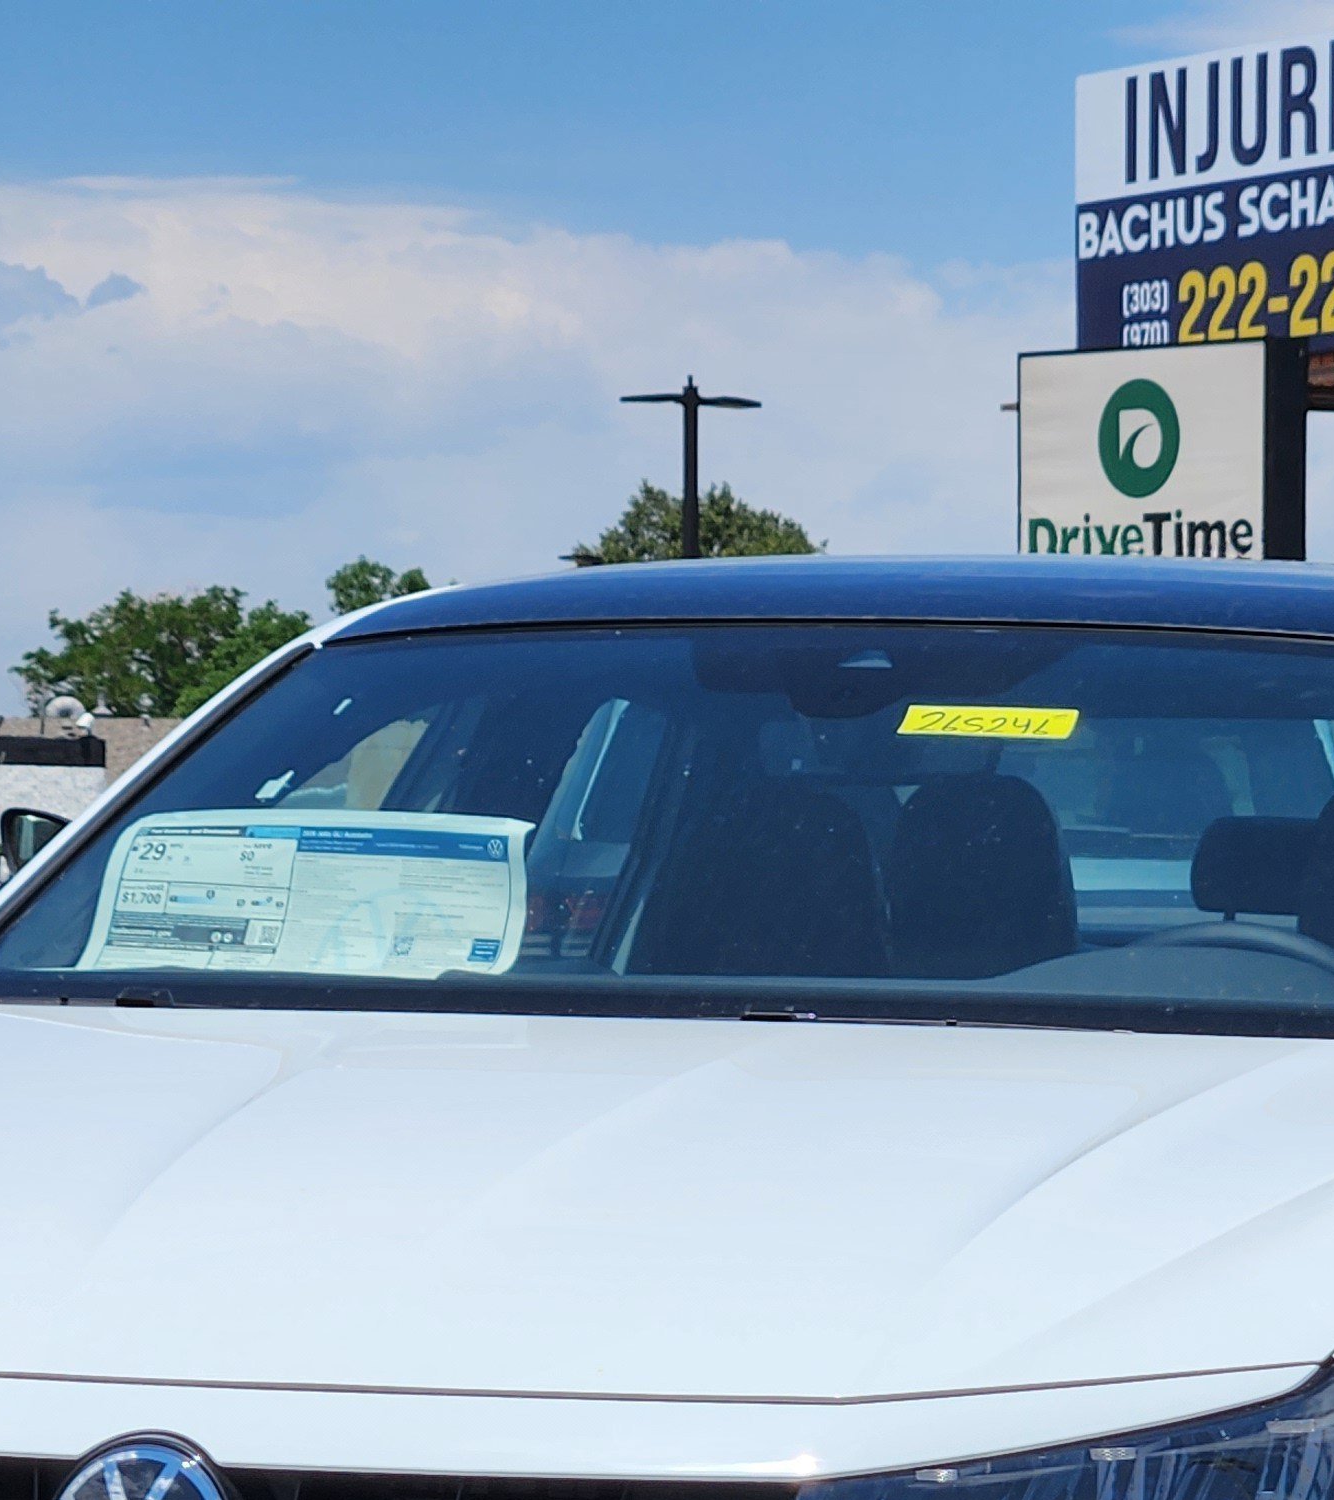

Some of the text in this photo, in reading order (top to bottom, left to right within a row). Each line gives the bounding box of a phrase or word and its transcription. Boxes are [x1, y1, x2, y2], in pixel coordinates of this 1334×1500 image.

[1078, 191, 1226, 260] BACHUS
[1123, 279, 1169, 318] (303)
[1028, 509, 1254, 558] DriveTime
